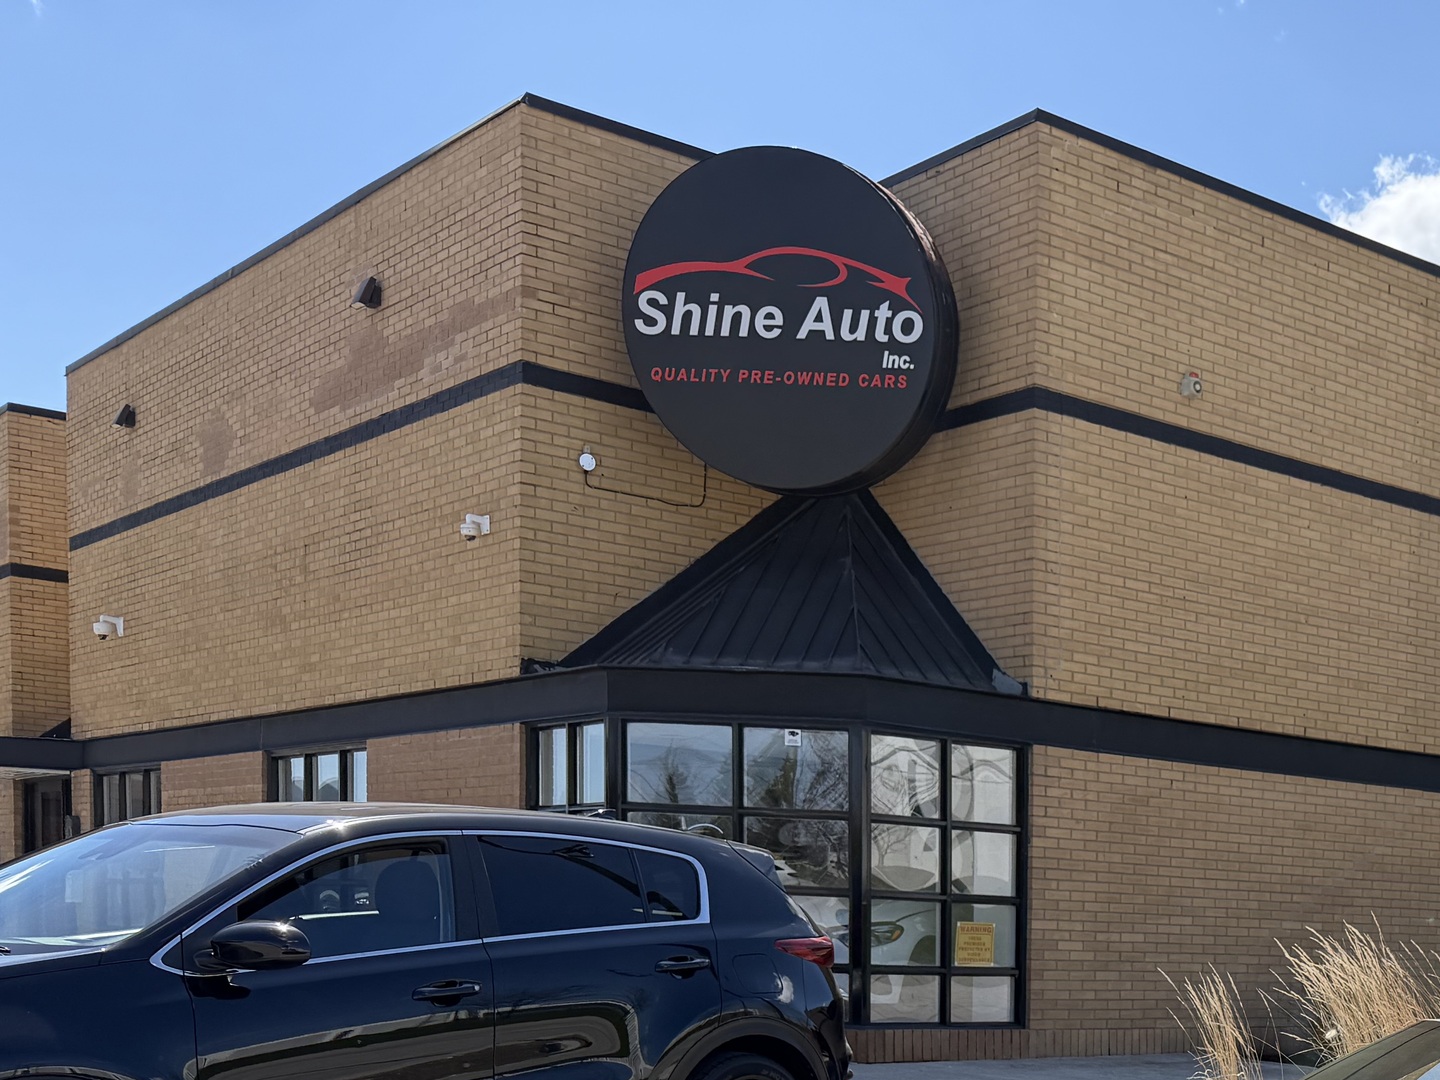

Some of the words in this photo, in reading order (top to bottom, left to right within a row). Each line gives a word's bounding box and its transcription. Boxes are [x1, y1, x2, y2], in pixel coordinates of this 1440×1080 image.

[634, 290, 784, 339] Shine
[796, 296, 924, 344] Auto
[882, 350, 915, 370] Inc.
[650, 366, 731, 383] QUALITY
[738, 369, 850, 387] PRE-OWNED
[857, 373, 908, 389] CARS
